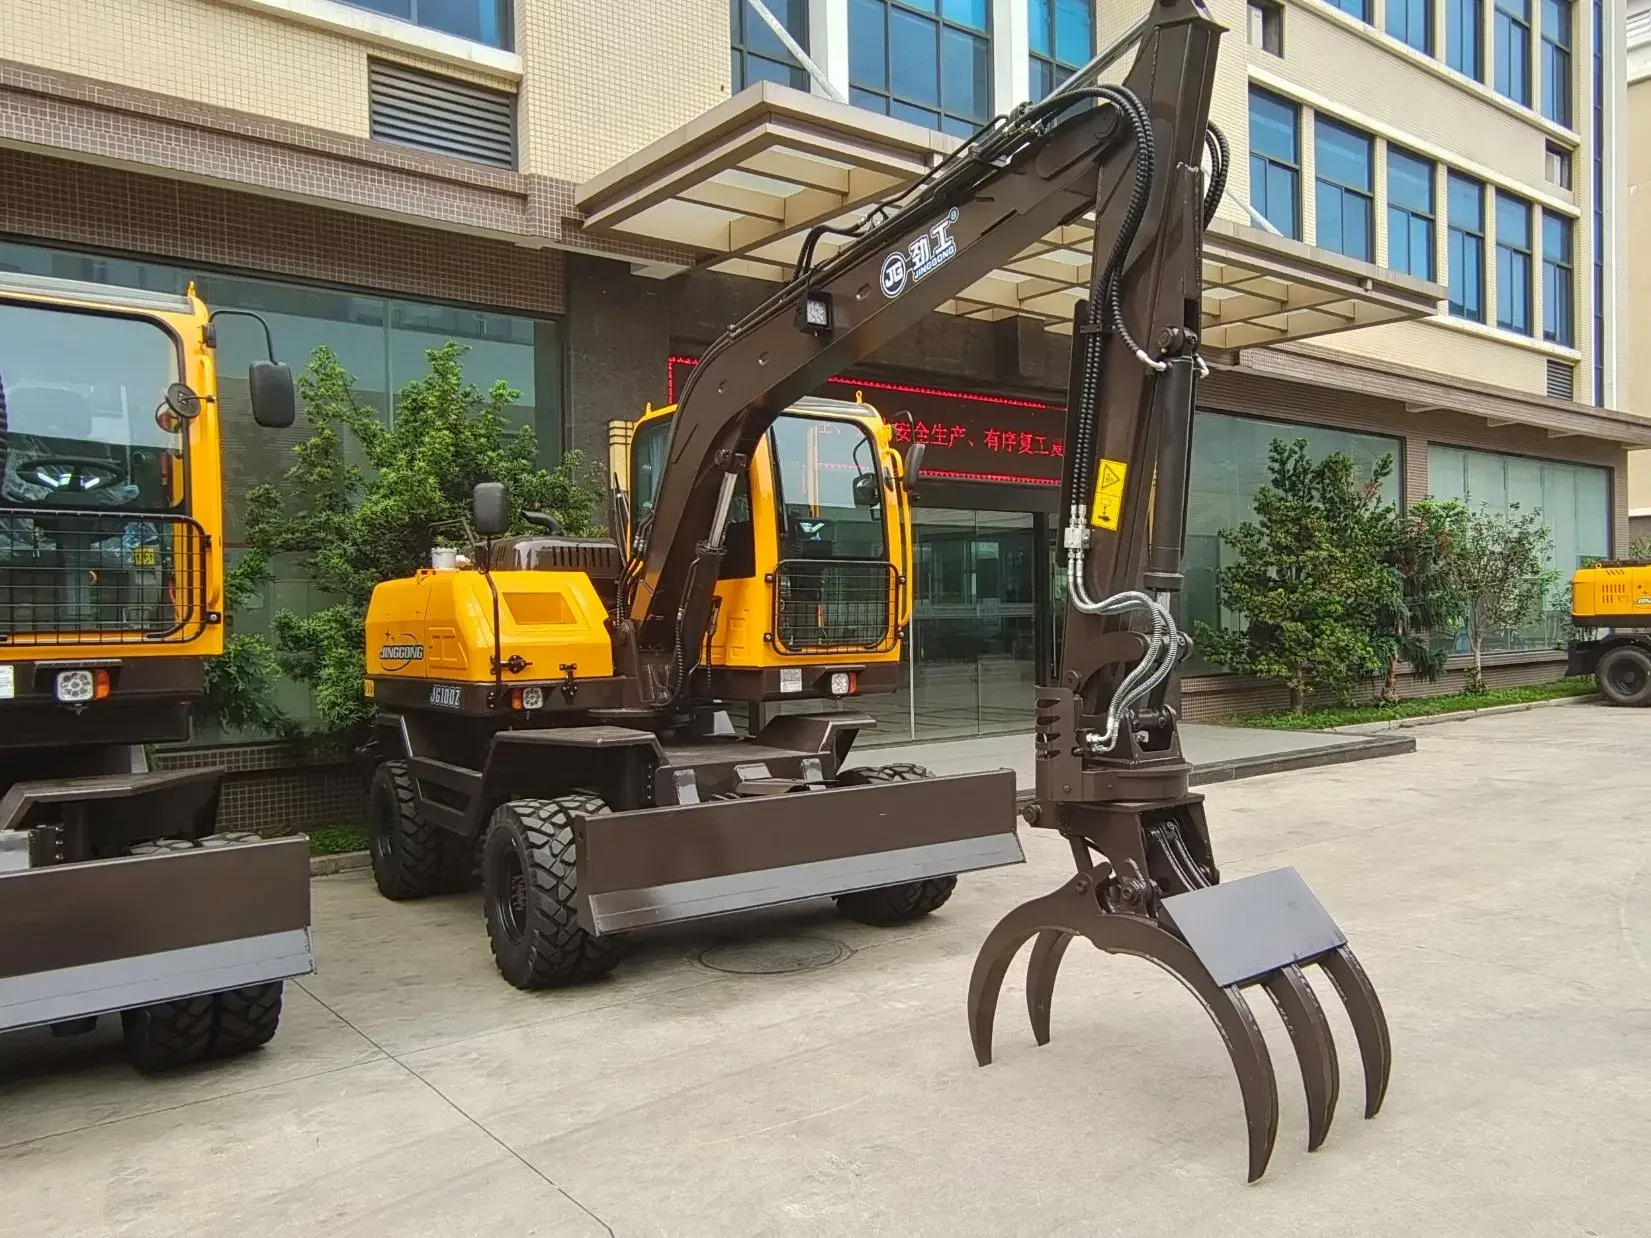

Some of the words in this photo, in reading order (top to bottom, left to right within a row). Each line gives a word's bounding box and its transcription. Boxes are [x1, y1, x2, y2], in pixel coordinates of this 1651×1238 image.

[914, 246, 955, 279] JINGGONG
[884, 261, 904, 288] JG
[379, 646, 423, 659] JINGGONG
[430, 686, 460, 706] JG100Z
